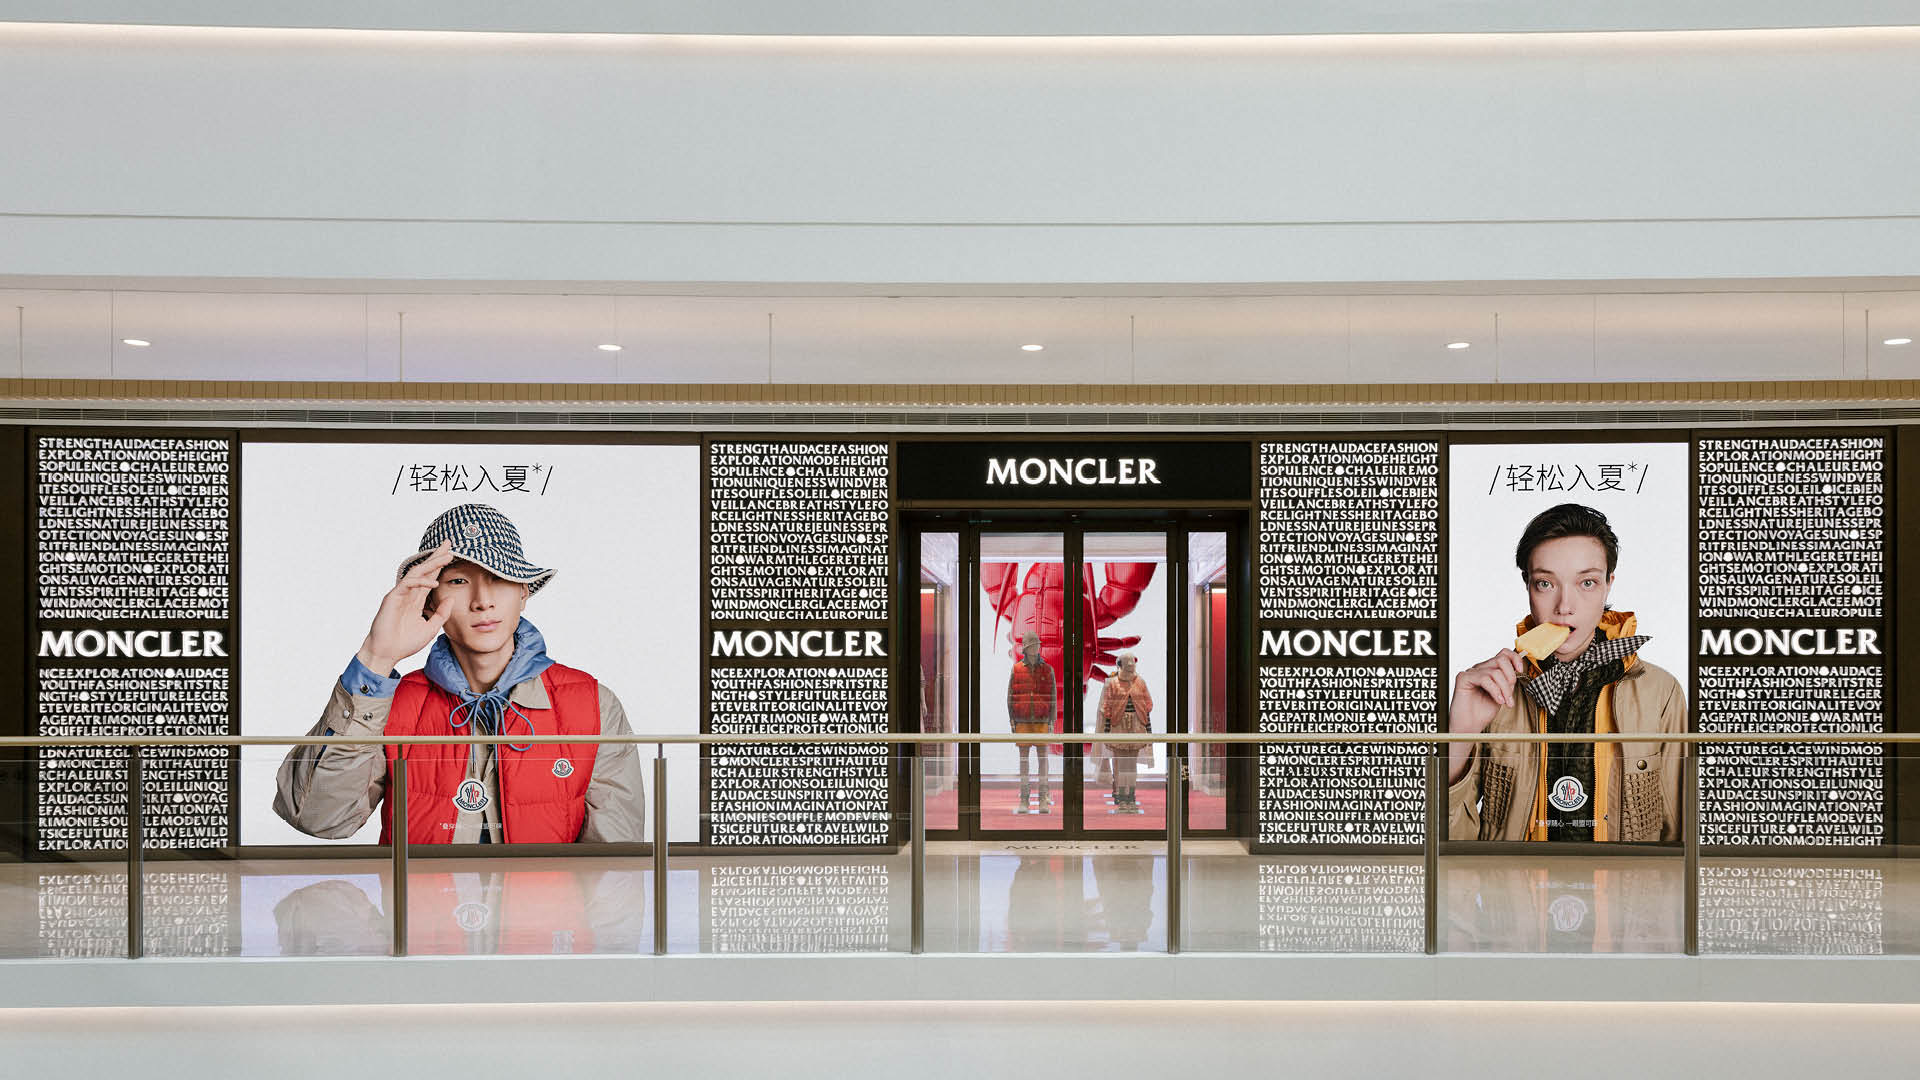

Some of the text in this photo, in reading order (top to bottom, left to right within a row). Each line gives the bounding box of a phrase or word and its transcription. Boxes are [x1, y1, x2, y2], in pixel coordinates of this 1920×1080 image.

[711, 444, 888, 455] STRENGTHAUDACEFASHION
[1261, 443, 1437, 453] STRENGTHAUDACEFASHION
[711, 455, 888, 466] EXPLORATIONMODEHEIGHT
[1261, 454, 1438, 464] EXPLORATIONMODEHEIGHT
[986, 458, 1162, 485] MONCLER
[711, 477, 887, 489] TIONUNIQUENESSWINDVER
[1261, 476, 1437, 488] TIONUNIQUENESSWINDVER
[712, 500, 888, 510] VEILLANCEBREATHSTYLEFO
[1261, 499, 1438, 509] VEILLANCEBREATHSTYLEFO
[712, 511, 888, 521] RCELIGHTNESSHERITAGEBO
[1261, 510, 1438, 520] RCELIGHTNESSHERITAGEBO
[712, 522, 887, 534] LDNESSNATUREJEUNESSEPR
[1261, 521, 1436, 533] LDNESSNATUREJEUNESSEPR
[712, 544, 888, 554] RITFRIENDLINESSIMAGINAT
[1260, 543, 1437, 553] RITFRIENDLINESSIMAGINAT
[711, 577, 887, 587] ONSAUVAGENATURESOLEIL
[1260, 576, 1437, 586] ONSAUVAGENATURESOLEIL
[712, 599, 888, 610] WINDMONCLERGLACEEMOT
[1260, 598, 1437, 609] WINDMONCLERGLACEEMOT
[711, 610, 888, 621] IONUNIQUECHALEUROPULE
[1260, 609, 1437, 620] IONUNIQUECHALEUROPULE
[38, 629, 228, 658] MONCLER
[711, 630, 887, 658] MONCLER
[1260, 629, 1436, 657] MONCLER
[1699, 628, 1881, 656] MONCLER
[712, 679, 888, 689] YOUTHFASHIONESPRITSTRE
[1260, 678, 1437, 688] YOUTHFASHIONESPRITSTRE
[711, 701, 887, 712] ETEVERITEORIGINALITEVOY
[1260, 700, 1437, 711] ETEVERITEORIGINALITEVOY
[712, 723, 888, 734] SOUFFLEICEPROTECTIONLIG
[1260, 723, 1437, 733] SOUFFLEICEPROTECTIONLIG
[458, 798, 486, 809] MONCLER
[1554, 796, 1582, 807] MONCLER
